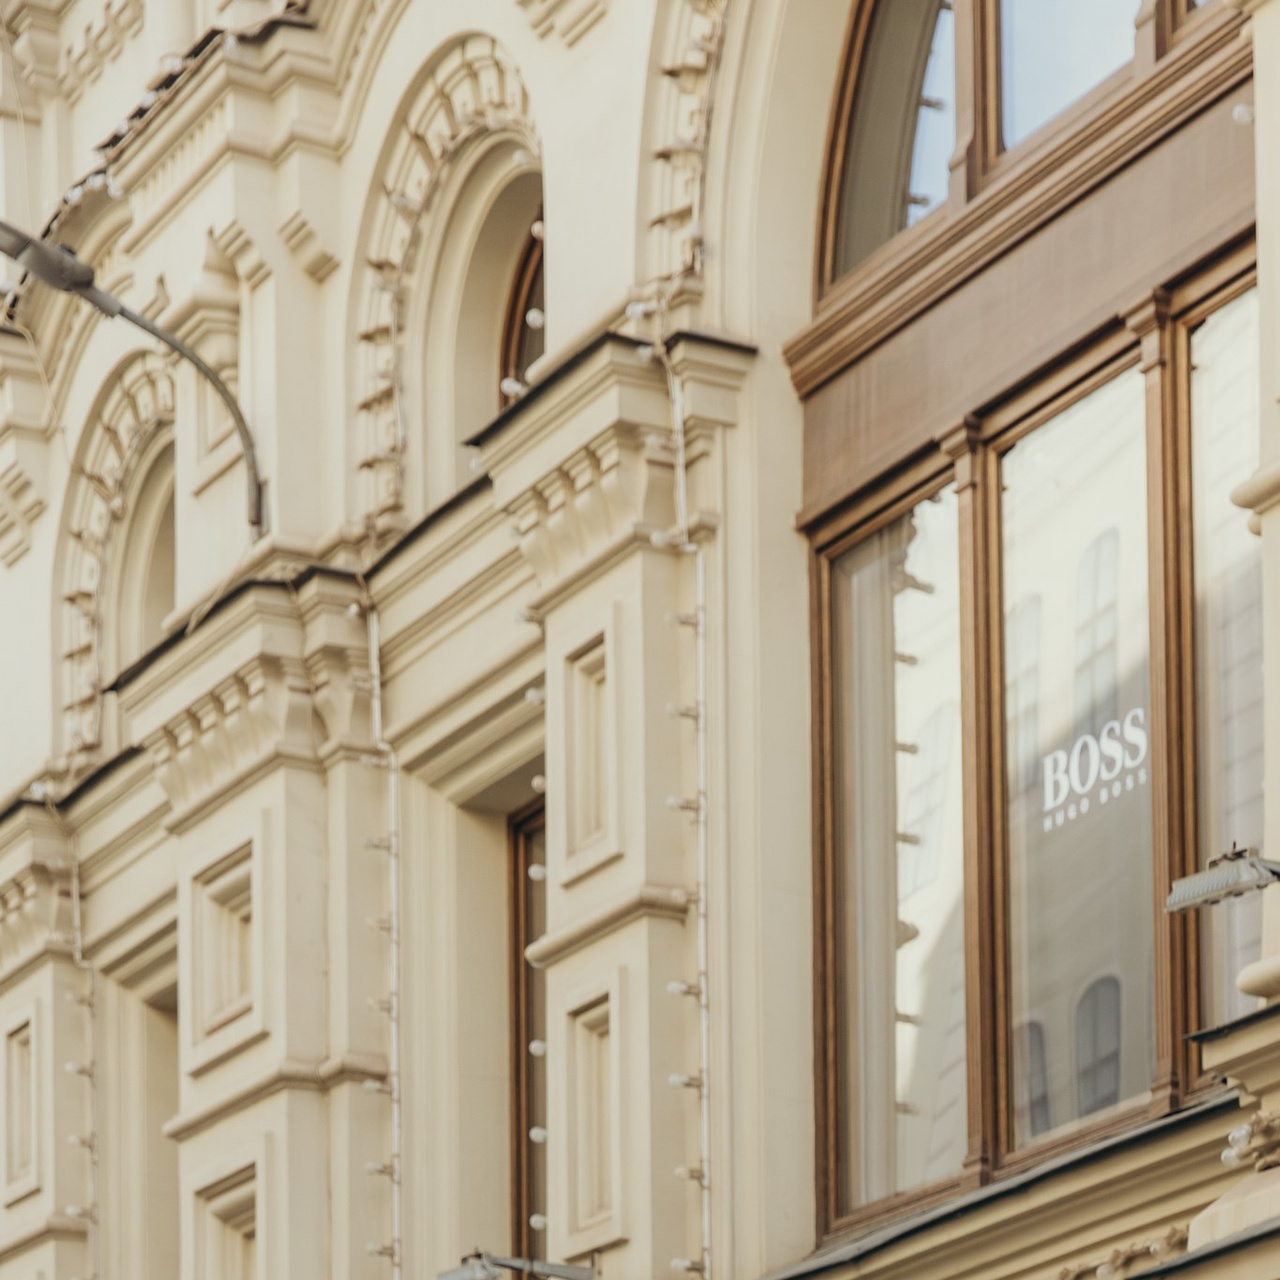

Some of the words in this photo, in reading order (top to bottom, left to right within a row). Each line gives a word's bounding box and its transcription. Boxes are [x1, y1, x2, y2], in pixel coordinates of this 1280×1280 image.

[1043, 708, 1148, 812] BOSS
[1044, 797, 1090, 832] HUGO
[1099, 769, 1147, 804] BOSS
